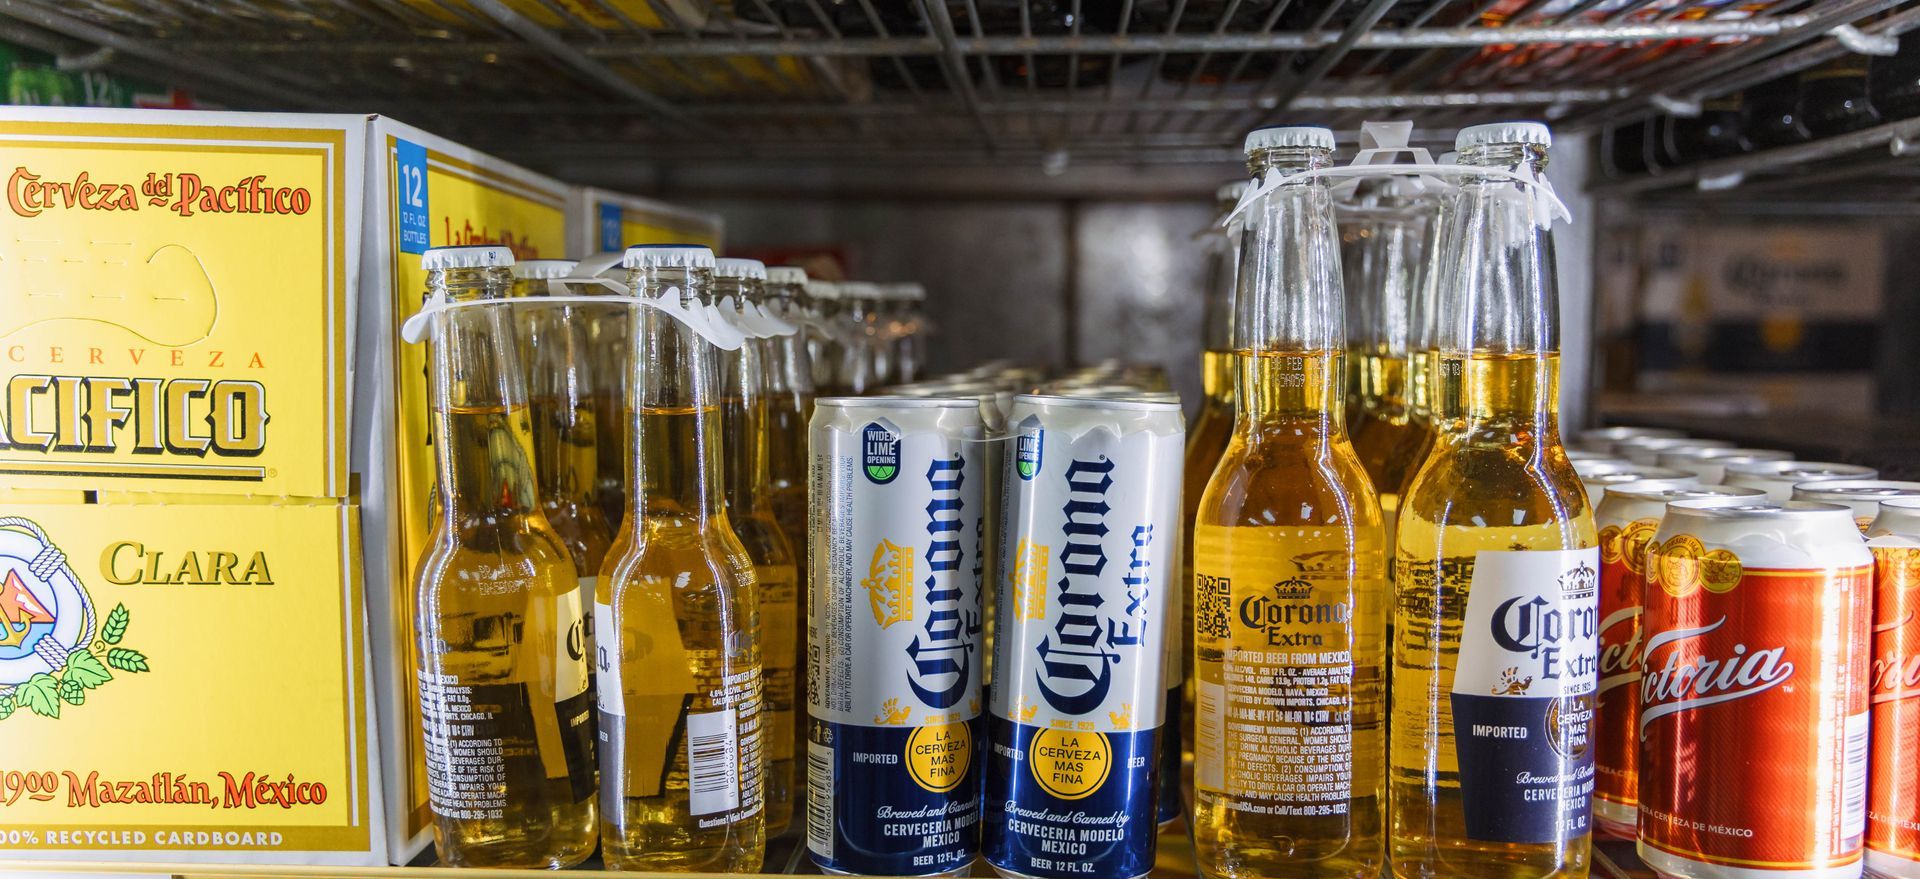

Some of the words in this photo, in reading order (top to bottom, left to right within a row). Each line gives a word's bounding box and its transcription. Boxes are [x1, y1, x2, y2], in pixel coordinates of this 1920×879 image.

[7, 167, 138, 218] Cerveza
[142, 172, 173, 206] del
[171, 173, 311, 216] Pacífico
[403, 164, 422, 208] 12
[403, 211, 409, 223] 12
[410, 212, 416, 225] FL
[418, 214, 426, 228] OZ
[404, 230, 427, 245] BOTTLES
[8, 345, 266, 369] CERVEZA
[867, 430, 896, 442] WIDER
[867, 443, 896, 456] LIME
[867, 456, 896, 464] OPENING
[99, 541, 275, 586] CLARA
[906, 455, 973, 709] Corona
[1036, 457, 1120, 715] Corona
[1106, 523, 1153, 649] Extra
[845, 633, 851, 641] OR
[1267, 626, 1323, 646] Extra
[1267, 652, 1287, 664] BEER
[1291, 653, 1316, 664] FROM
[1319, 651, 1350, 664] MEXICO
[1640, 615, 1794, 712] ictoria
[1573, 700, 1584, 711] LA
[1050, 719, 1073, 729] SINCE
[1557, 710, 1593, 725] CERVEZA
[936, 731, 951, 741] LA
[1228, 722, 1264, 733] GOVERNMENT
[1266, 726, 1298, 735] WARNING:
[1300, 726, 1308, 737] (1)
[1310, 725, 1344, 735] ACCORDING
[1472, 724, 1528, 739] IMPORTED
[1569, 724, 1586, 734] MAS
[1061, 737, 1079, 747] LA
[1240, 734, 1267, 743] SURGEON
[1270, 736, 1300, 745] GENERAL,
[1303, 736, 1328, 745] WOMEN
[1568, 735, 1586, 746] FINA
[477, 747, 503, 755] SHOULD
[915, 740, 966, 755] CERVEZA
[994, 743, 1023, 761] IMPORTED
[1039, 747, 1101, 761] CERVEZA
[1240, 744, 1258, 752] DRINK
[1261, 745, 1297, 754] ALCOHOLIC
[1299, 745, 1336, 754] BEVERAGES
[853, 752, 898, 765] IMPORTED
[931, 755, 955, 765] MAS
[1238, 753, 1273, 763] PREGNANCY
[1276, 755, 1304, 764] BECAUSE
[1307, 755, 1315, 764] OF
[1317, 755, 1328, 763] THE
[1330, 754, 1344, 763] RISK
[930, 769, 955, 778] FINA
[1054, 762, 1084, 772] MAS
[824, 768, 832, 800] 95685
[1052, 774, 1084, 784] FINA
[1264, 773, 1303, 782] BEVERAGES
[1306, 773, 1333, 782] IMPAIRS
[1516, 771, 1559, 784] Brewed
[62, 771, 219, 809] Mazatlán,
[218, 771, 327, 809] México
[1245, 791, 1256, 799] AND
[1259, 792, 1272, 800] MAY
[1274, 792, 1293, 801] CAUSE
[1296, 792, 1319, 802] HEALTH
[453, 800, 472, 808] HEALTH
[877, 805, 927, 819] Brewed
[926, 801, 948, 818] and
[1274, 805, 1302, 815] Call/Text
[1303, 804, 1346, 815] 800-295-1032
[461, 810, 503, 819] 800-295-1032
[1005, 800, 1048, 820] Brewed
[1046, 811, 1072, 823] and
[1072, 810, 1119, 825] Canned
[1116, 811, 1130, 829] by
[824, 806, 832, 838] 80660
[884, 820, 952, 836] CERVECERIA
[1654, 810, 1690, 828] CERVEZA
[1693, 821, 1705, 832] DE
[1708, 824, 1753, 838] MÉXICO
[1008, 818, 1076, 841] CERVECERIA
[1080, 828, 1124, 842] MODELO
[46, 830, 147, 845] RECYCLED
[154, 830, 283, 846] CARDBOARD
[923, 831, 960, 848] MEXICO
[1041, 839, 1087, 855] MEXICO
[913, 855, 933, 866] BEER
[937, 854, 945, 864] 12
[1031, 857, 1052, 870] BEER
[1056, 861, 1065, 871] 12
[1067, 862, 1079, 873] FL.
[1082, 862, 1095, 873] OZ.
